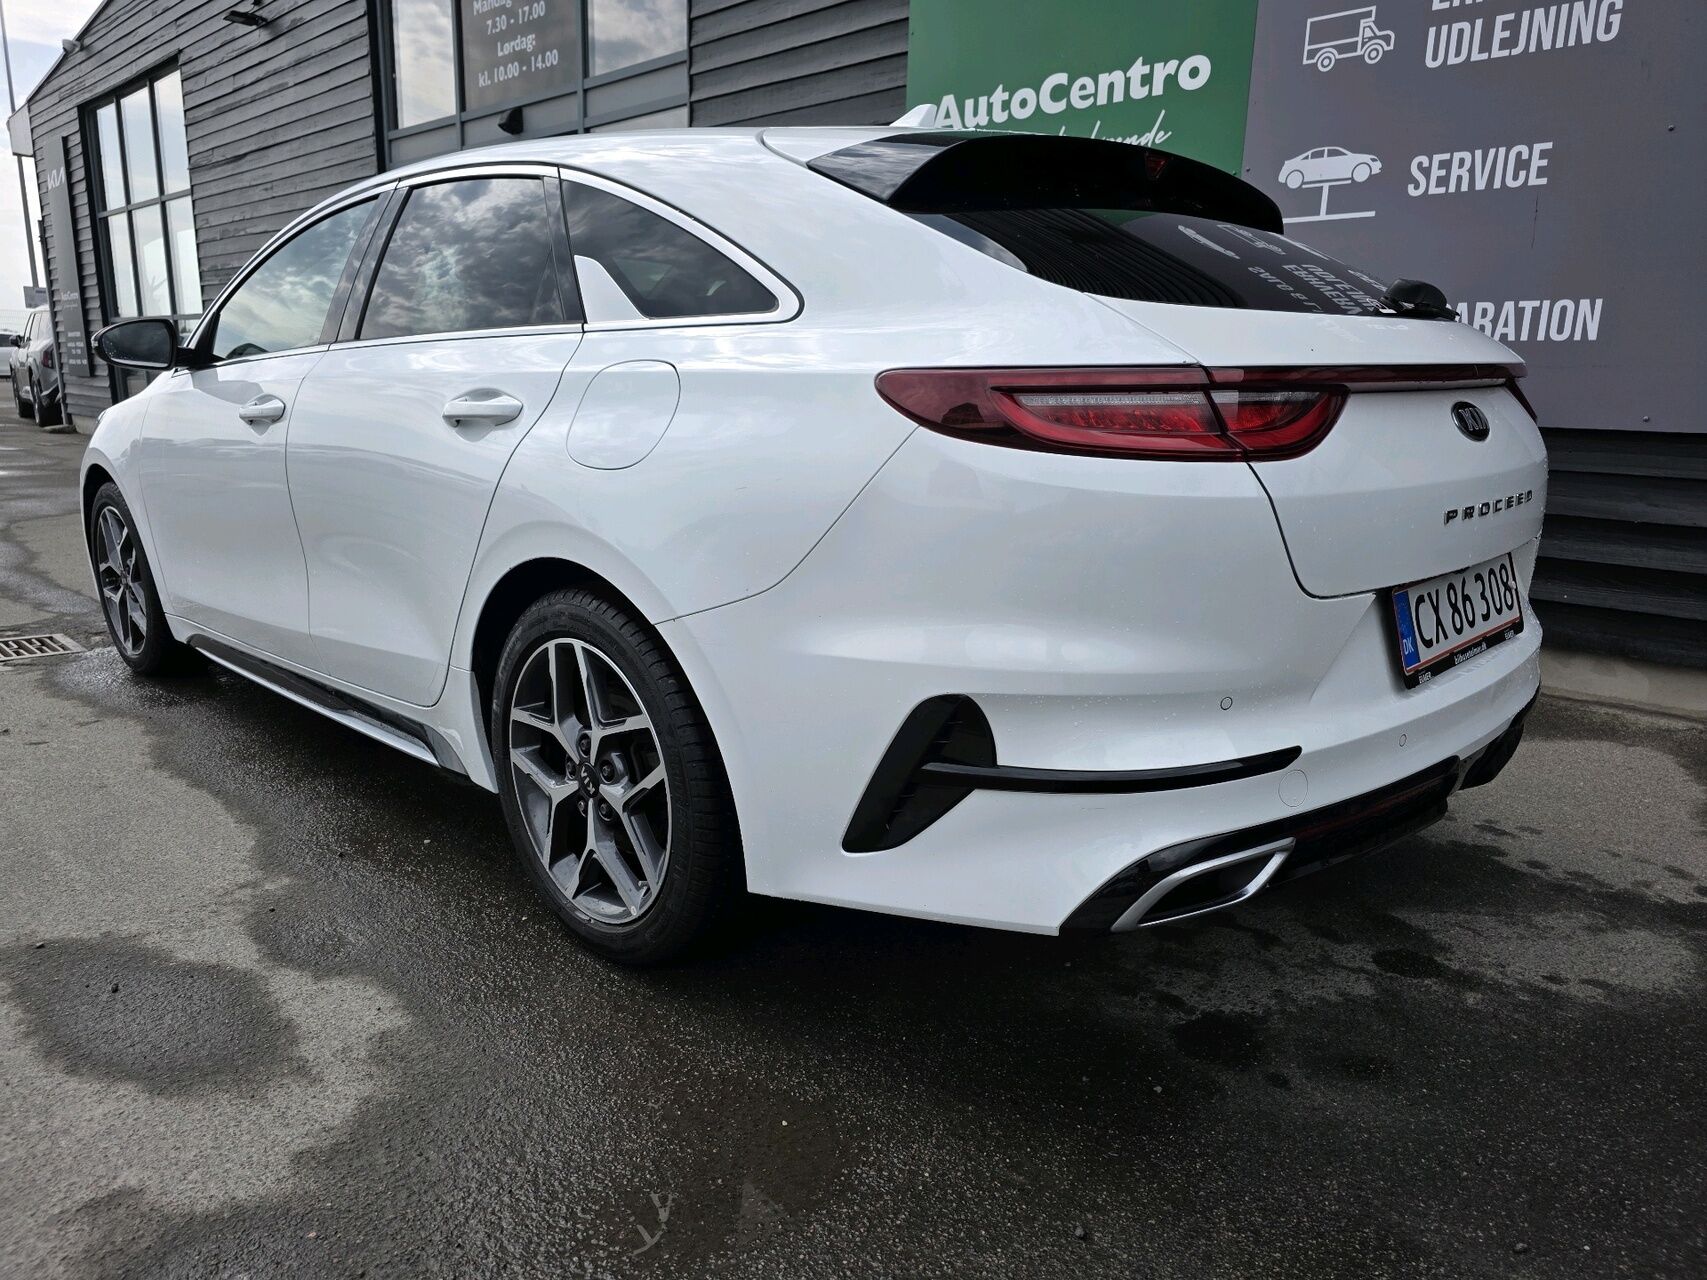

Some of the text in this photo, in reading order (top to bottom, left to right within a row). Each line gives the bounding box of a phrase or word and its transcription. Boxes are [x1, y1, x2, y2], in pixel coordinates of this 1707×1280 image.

[486, 15, 507, 35] 7.30
[519, 1, 545, 24] 17.00
[1425, 0, 1624, 69] UDLEJNING
[479, 70, 491, 87] kl.
[494, 62, 520, 82] 10.00
[531, 49, 559, 72] 14.00
[934, 54, 1212, 129] AutoCentro
[1407, 141, 1553, 197] SERVICE
[1455, 298, 1603, 341] ARATION
[1443, 489, 1533, 525] PROCEED
[1415, 563, 1514, 649] CX 86 308
[1402, 637, 1415, 655] DK
[581, 766, 595, 794] KIA
